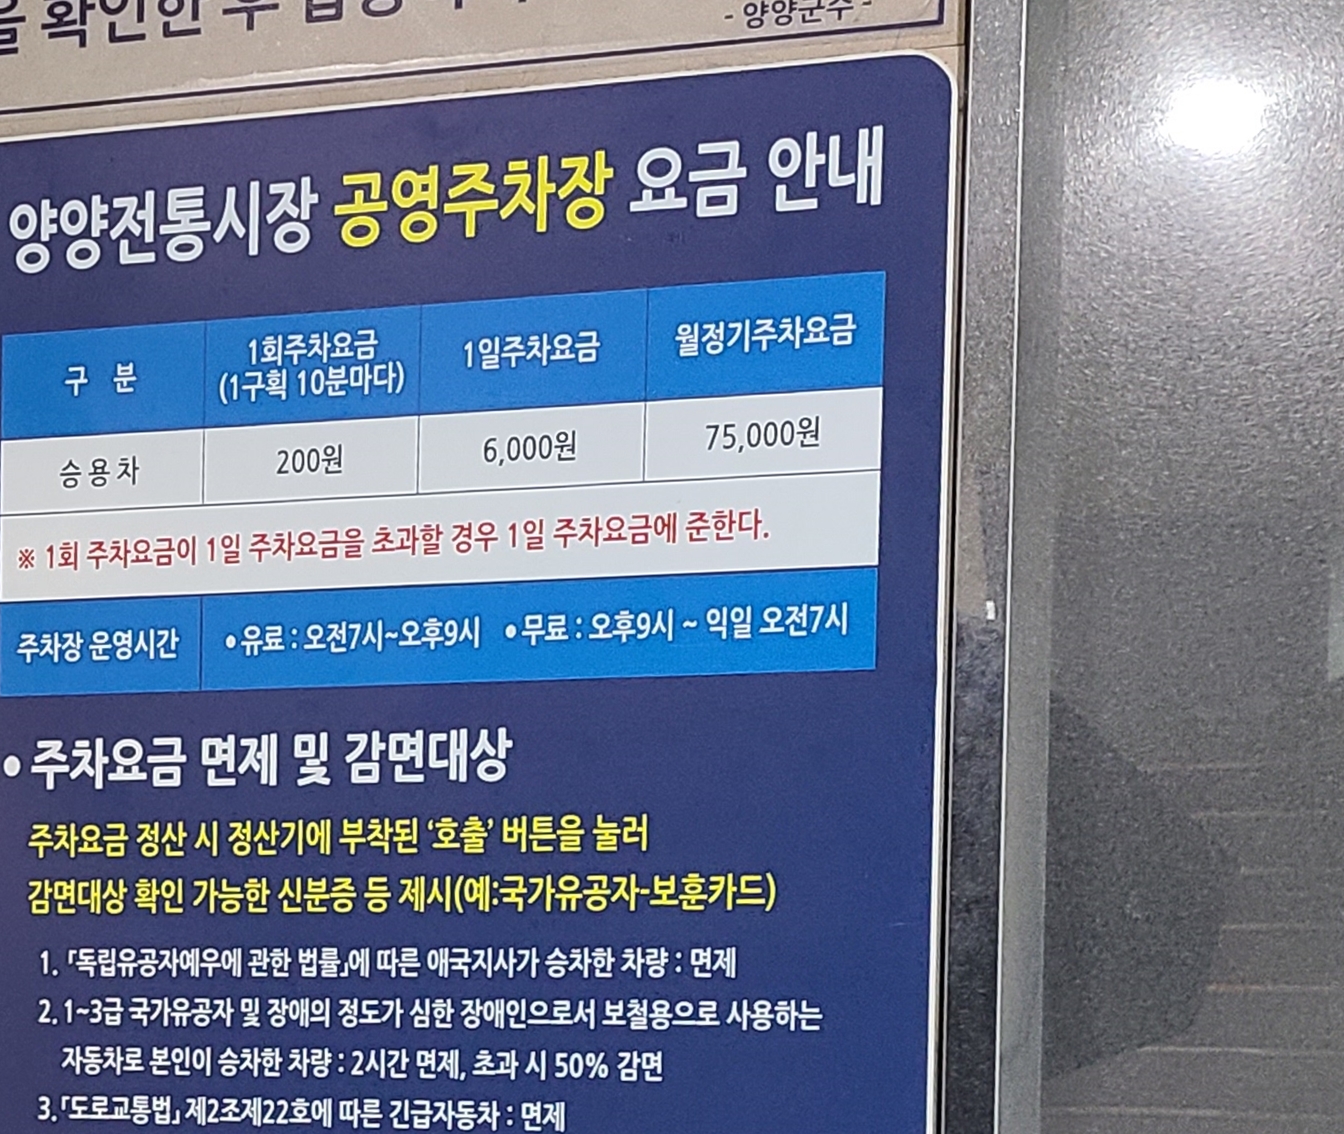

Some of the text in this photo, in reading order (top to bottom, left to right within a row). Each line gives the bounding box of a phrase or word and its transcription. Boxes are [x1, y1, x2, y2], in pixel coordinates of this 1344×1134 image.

[743, 0, 853, 28] 양양군수
[8, 123, 883, 274] 양양전통시장 공영주차장 요금 안내
[248, 328, 379, 367] 1회주차요금
[463, 330, 601, 370] 1일주차요금
[674, 312, 857, 357] 월정기주차요금
[219, 360, 404, 405] (1구획 10분마다)
[482, 428, 576, 466] 6,000원
[704, 415, 819, 453] 75,000원
[275, 442, 342, 475] 200원
[45, 507, 769, 571] 1회 주차요금이 1일 주차요금을 초과할 경우 1일 주차요금에 준한다.
[15, 627, 180, 663] 주차장 운영시간
[239, 601, 848, 656] 유료 오전7시~오후9시 무료 오후9시 익일 오전7시
[30, 726, 513, 790] 주차요금 면제 및 감면대상
[27, 812, 648, 859] 주차요금 정산 시 정산기에 부착된 ‘호출’ 버튼을 눌러
[27, 871, 776, 915] 감면대상 확인 가능한 신분증 등 제시(예:국가유공자-보훈카드)
[39, 945, 736, 979] 1. 「독립유공자예우에 관한 법률」에 따른 애국지사가 승차한 차량 면제
[36, 1094, 565, 1132] 3. 「도로교통법」 제2조제22호에 따른 긴급자동차 면제
